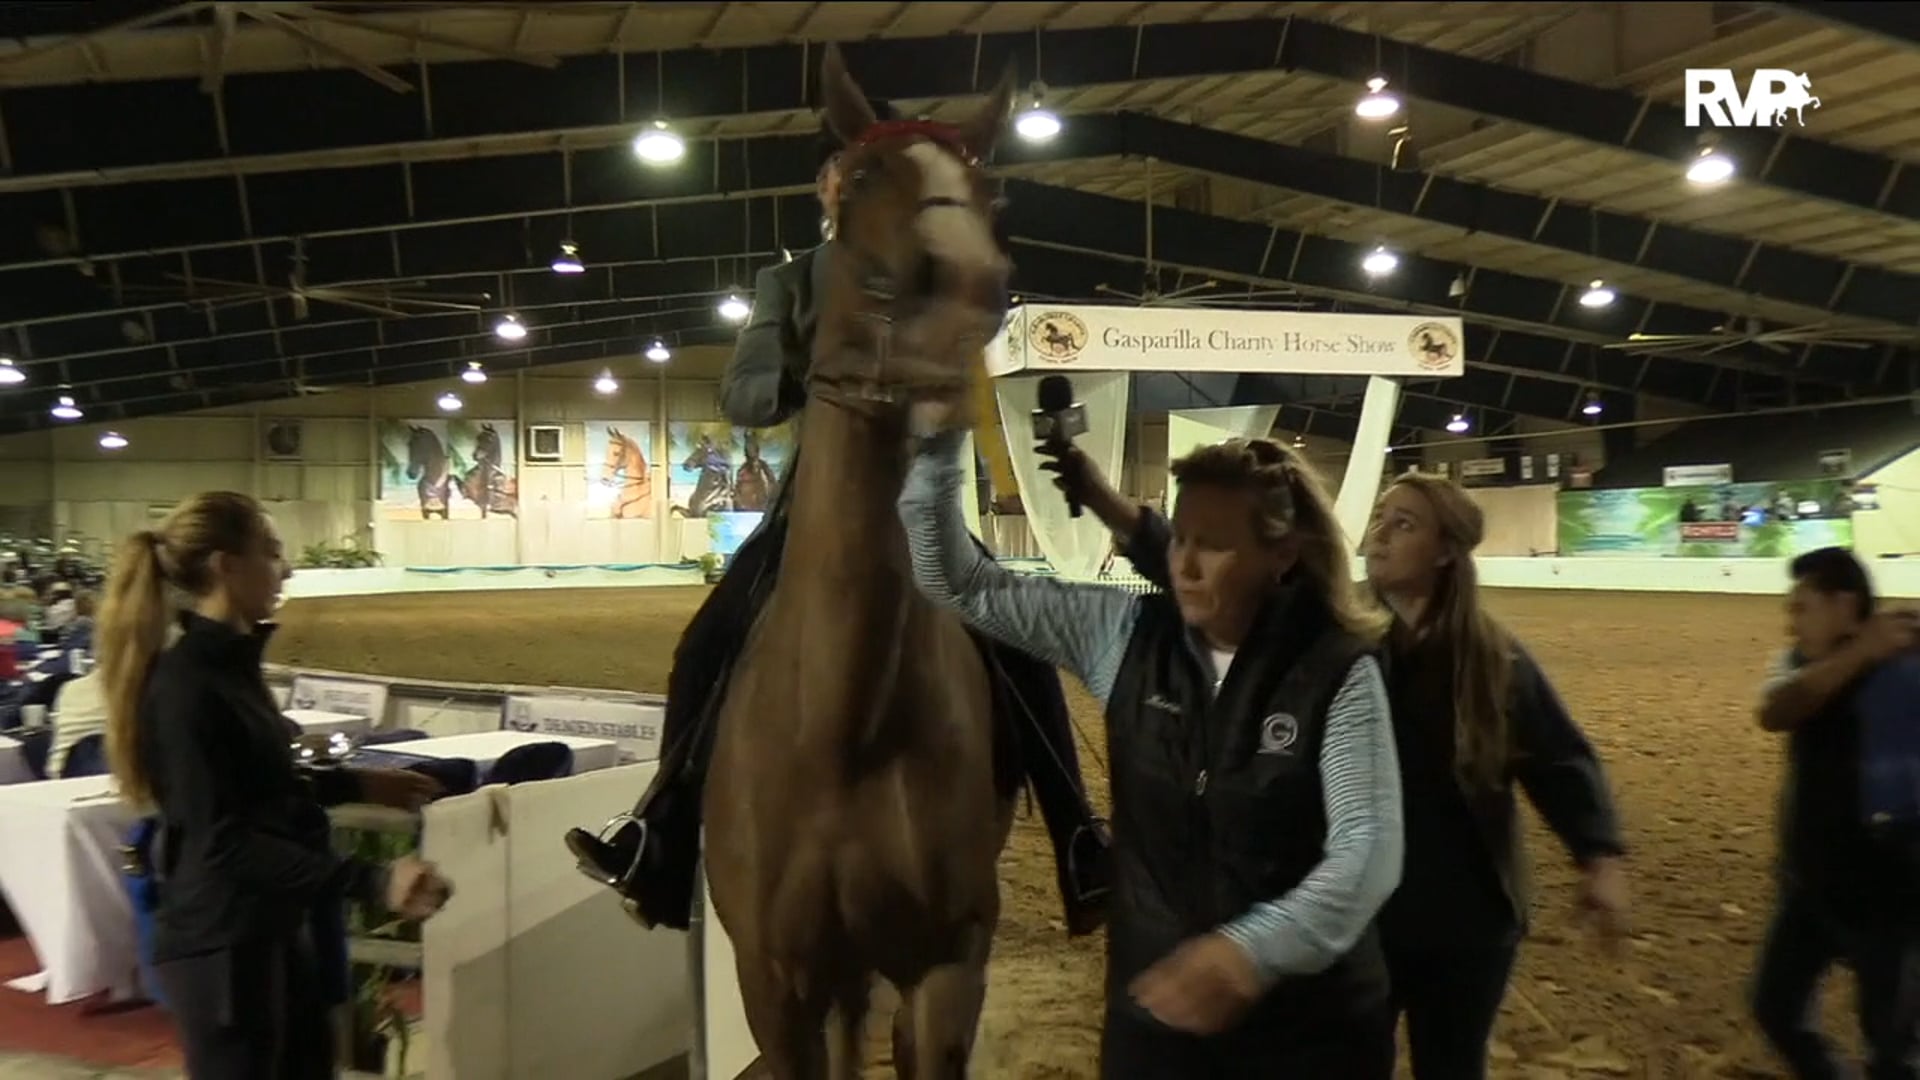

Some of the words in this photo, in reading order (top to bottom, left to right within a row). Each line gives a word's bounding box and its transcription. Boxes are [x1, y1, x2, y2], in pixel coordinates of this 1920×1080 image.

[1102, 326, 1201, 353] Gasparilla
[1207, 329, 1275, 356] Charity
[1284, 332, 1341, 353] Horse
[1346, 334, 1396, 354] Show
